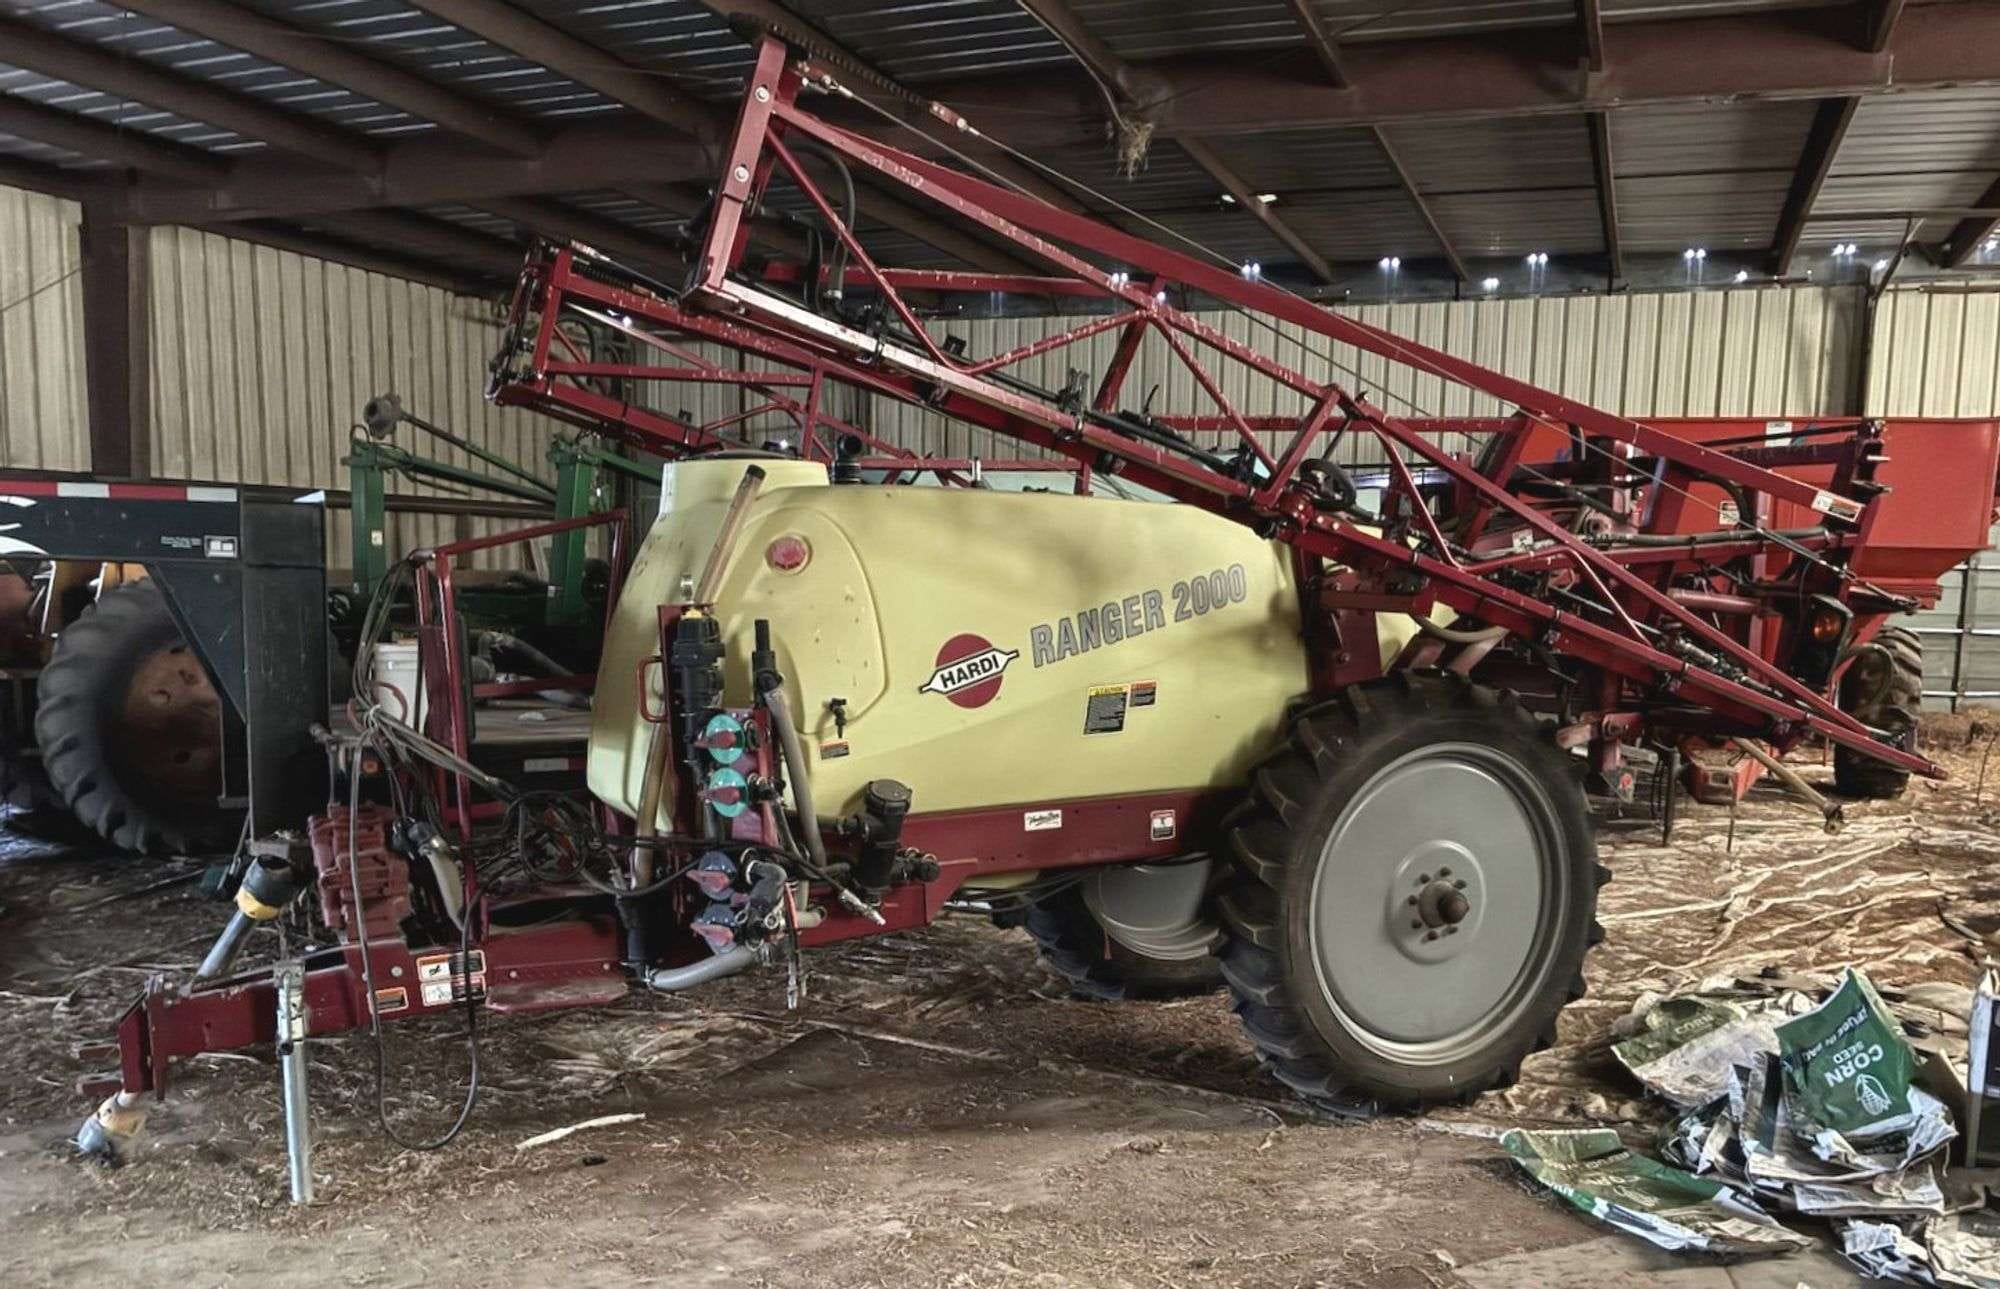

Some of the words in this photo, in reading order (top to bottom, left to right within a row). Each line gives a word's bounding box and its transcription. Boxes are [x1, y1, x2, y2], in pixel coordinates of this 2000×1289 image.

[1031, 589, 1166, 668] RANGER
[1172, 563, 1247, 623] 2000
[940, 655, 999, 688] HARDI
[1674, 1014, 1714, 1035] CORN
[1824, 1043, 1884, 1088] CORN
[1833, 1041, 1865, 1065] SEED
